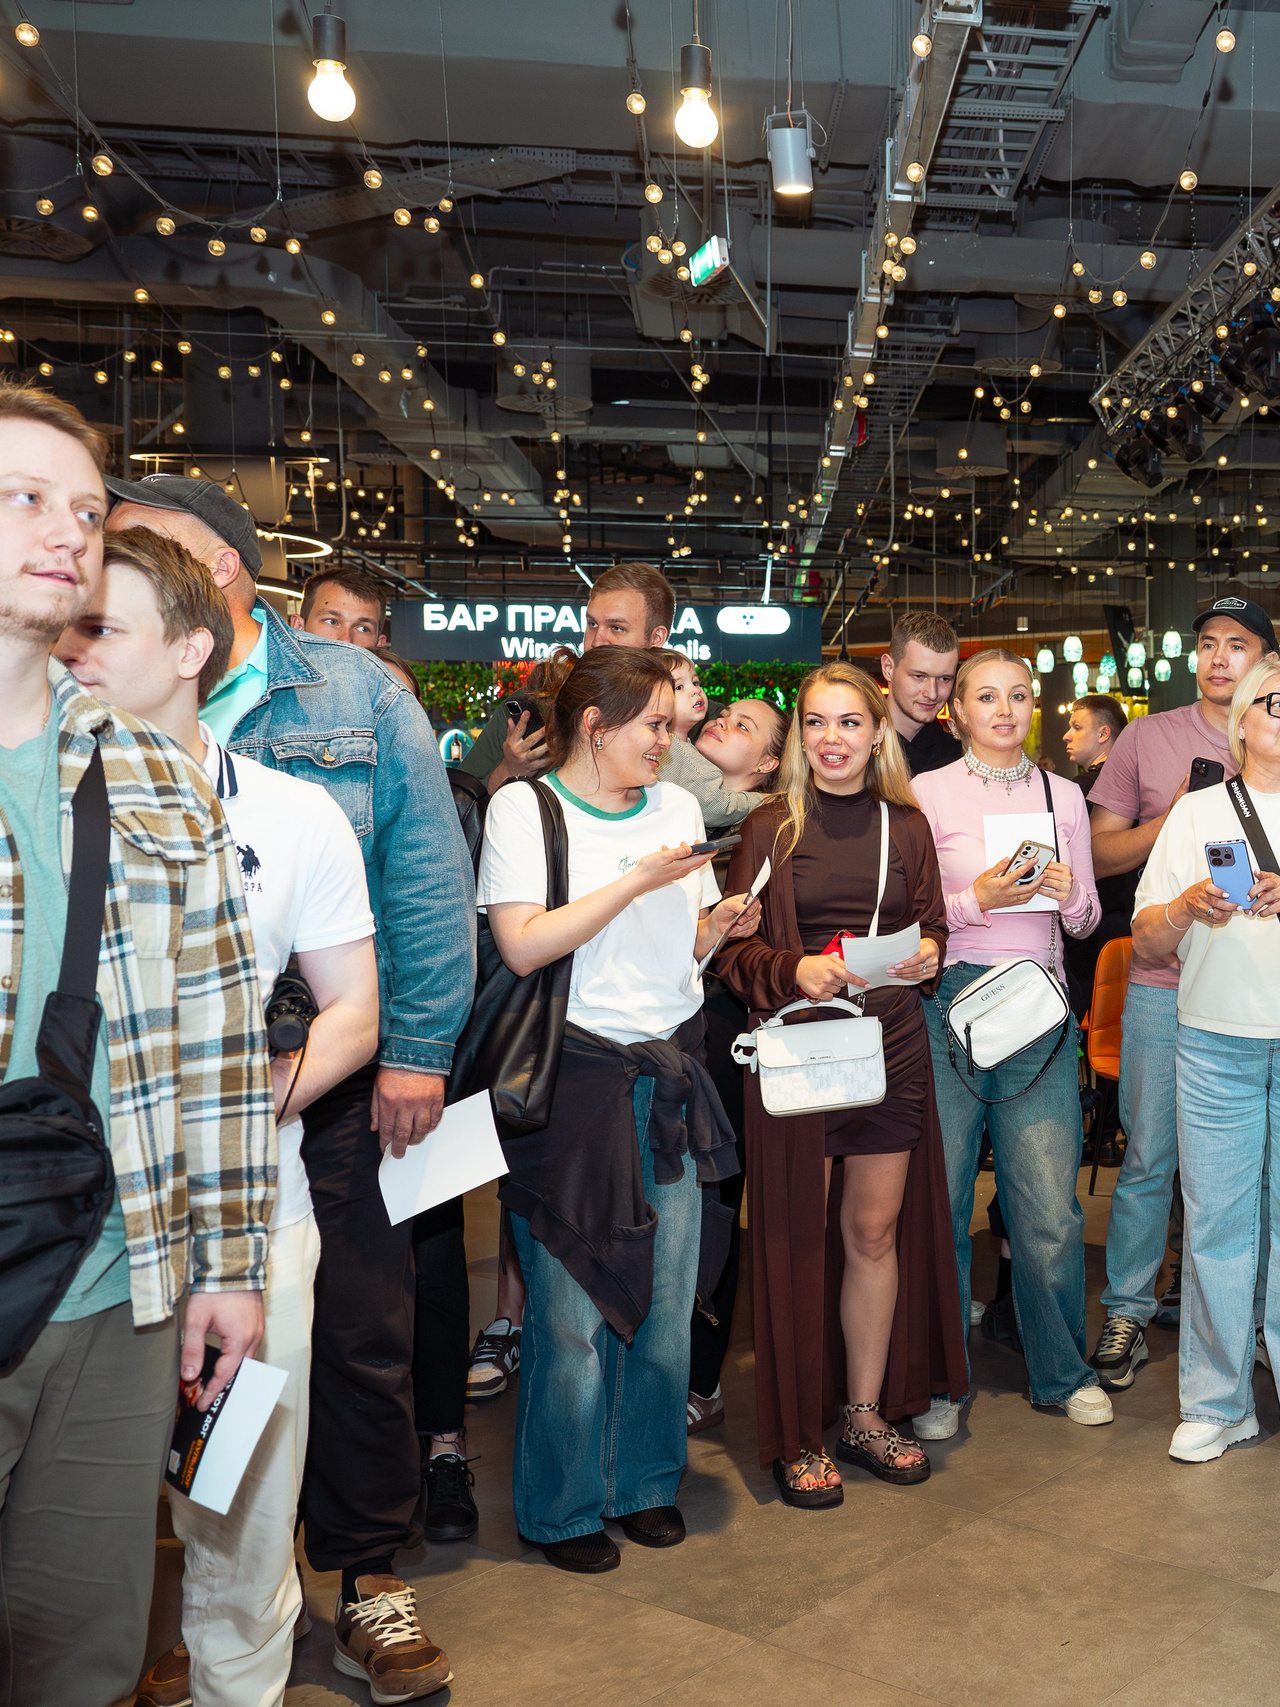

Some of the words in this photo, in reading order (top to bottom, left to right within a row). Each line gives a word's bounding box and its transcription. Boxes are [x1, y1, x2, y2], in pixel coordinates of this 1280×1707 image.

[423, 603, 499, 632] БАР
[507, 605, 703, 634] ПРАА
[980, 983, 1006, 1002] GUESS
[200, 1414, 213, 1438] ДОГ
